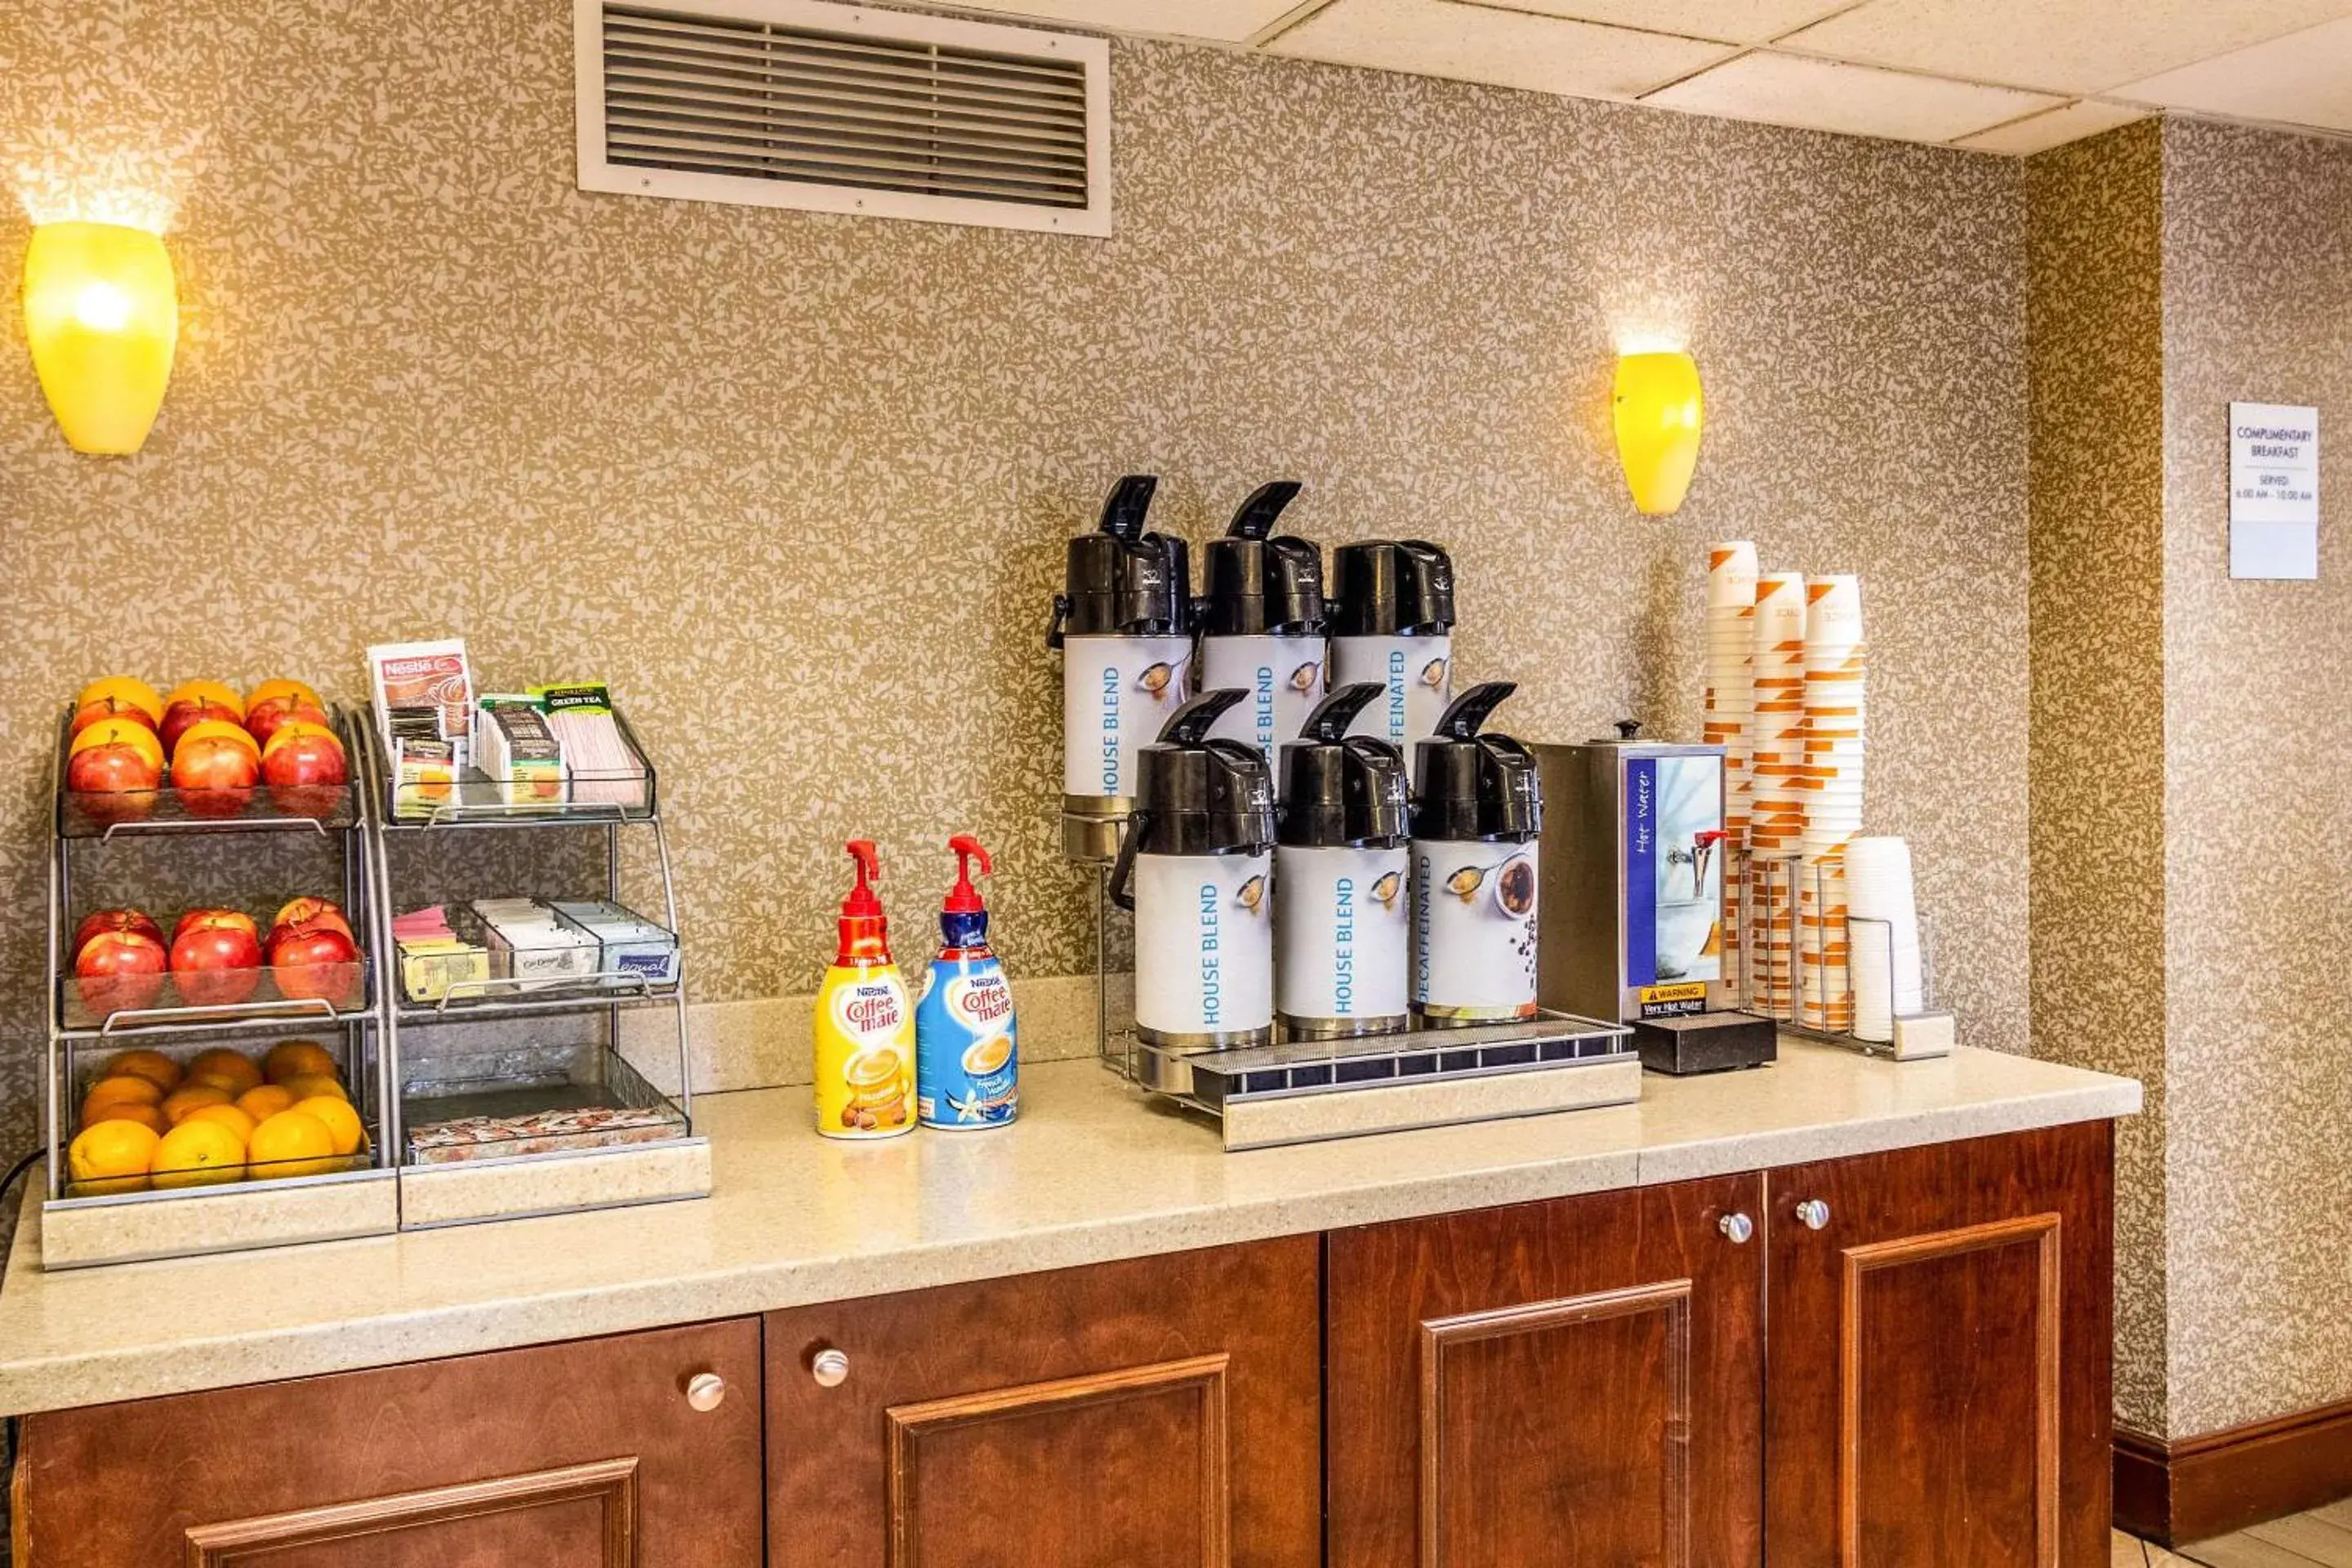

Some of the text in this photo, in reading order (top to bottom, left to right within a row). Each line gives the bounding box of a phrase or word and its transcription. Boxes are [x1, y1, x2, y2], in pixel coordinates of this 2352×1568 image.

[2237, 426, 2312, 442] COMPLIMENTARY
[2251, 444, 2299, 459] BREAKFAST
[582, 695, 602, 704] TEA
[1258, 666, 1272, 727] BLEND
[1103, 667, 1120, 797] HOUSE BLEND
[1636, 770, 1650, 853] Hot Water
[1418, 855, 1431, 1004] DECAFFEINATED
[1200, 884, 1220, 1025] HOUSE BLEND
[1335, 877, 1353, 1013] HOUSE BLEND
[962, 985, 1006, 1013] Coffee
[1659, 986, 1699, 999] WARNING
[846, 996, 894, 1023] Coffee
[860, 1009, 898, 1032] mate
[978, 997, 1011, 1022] mate
[1643, 1004, 1663, 1015] Very
